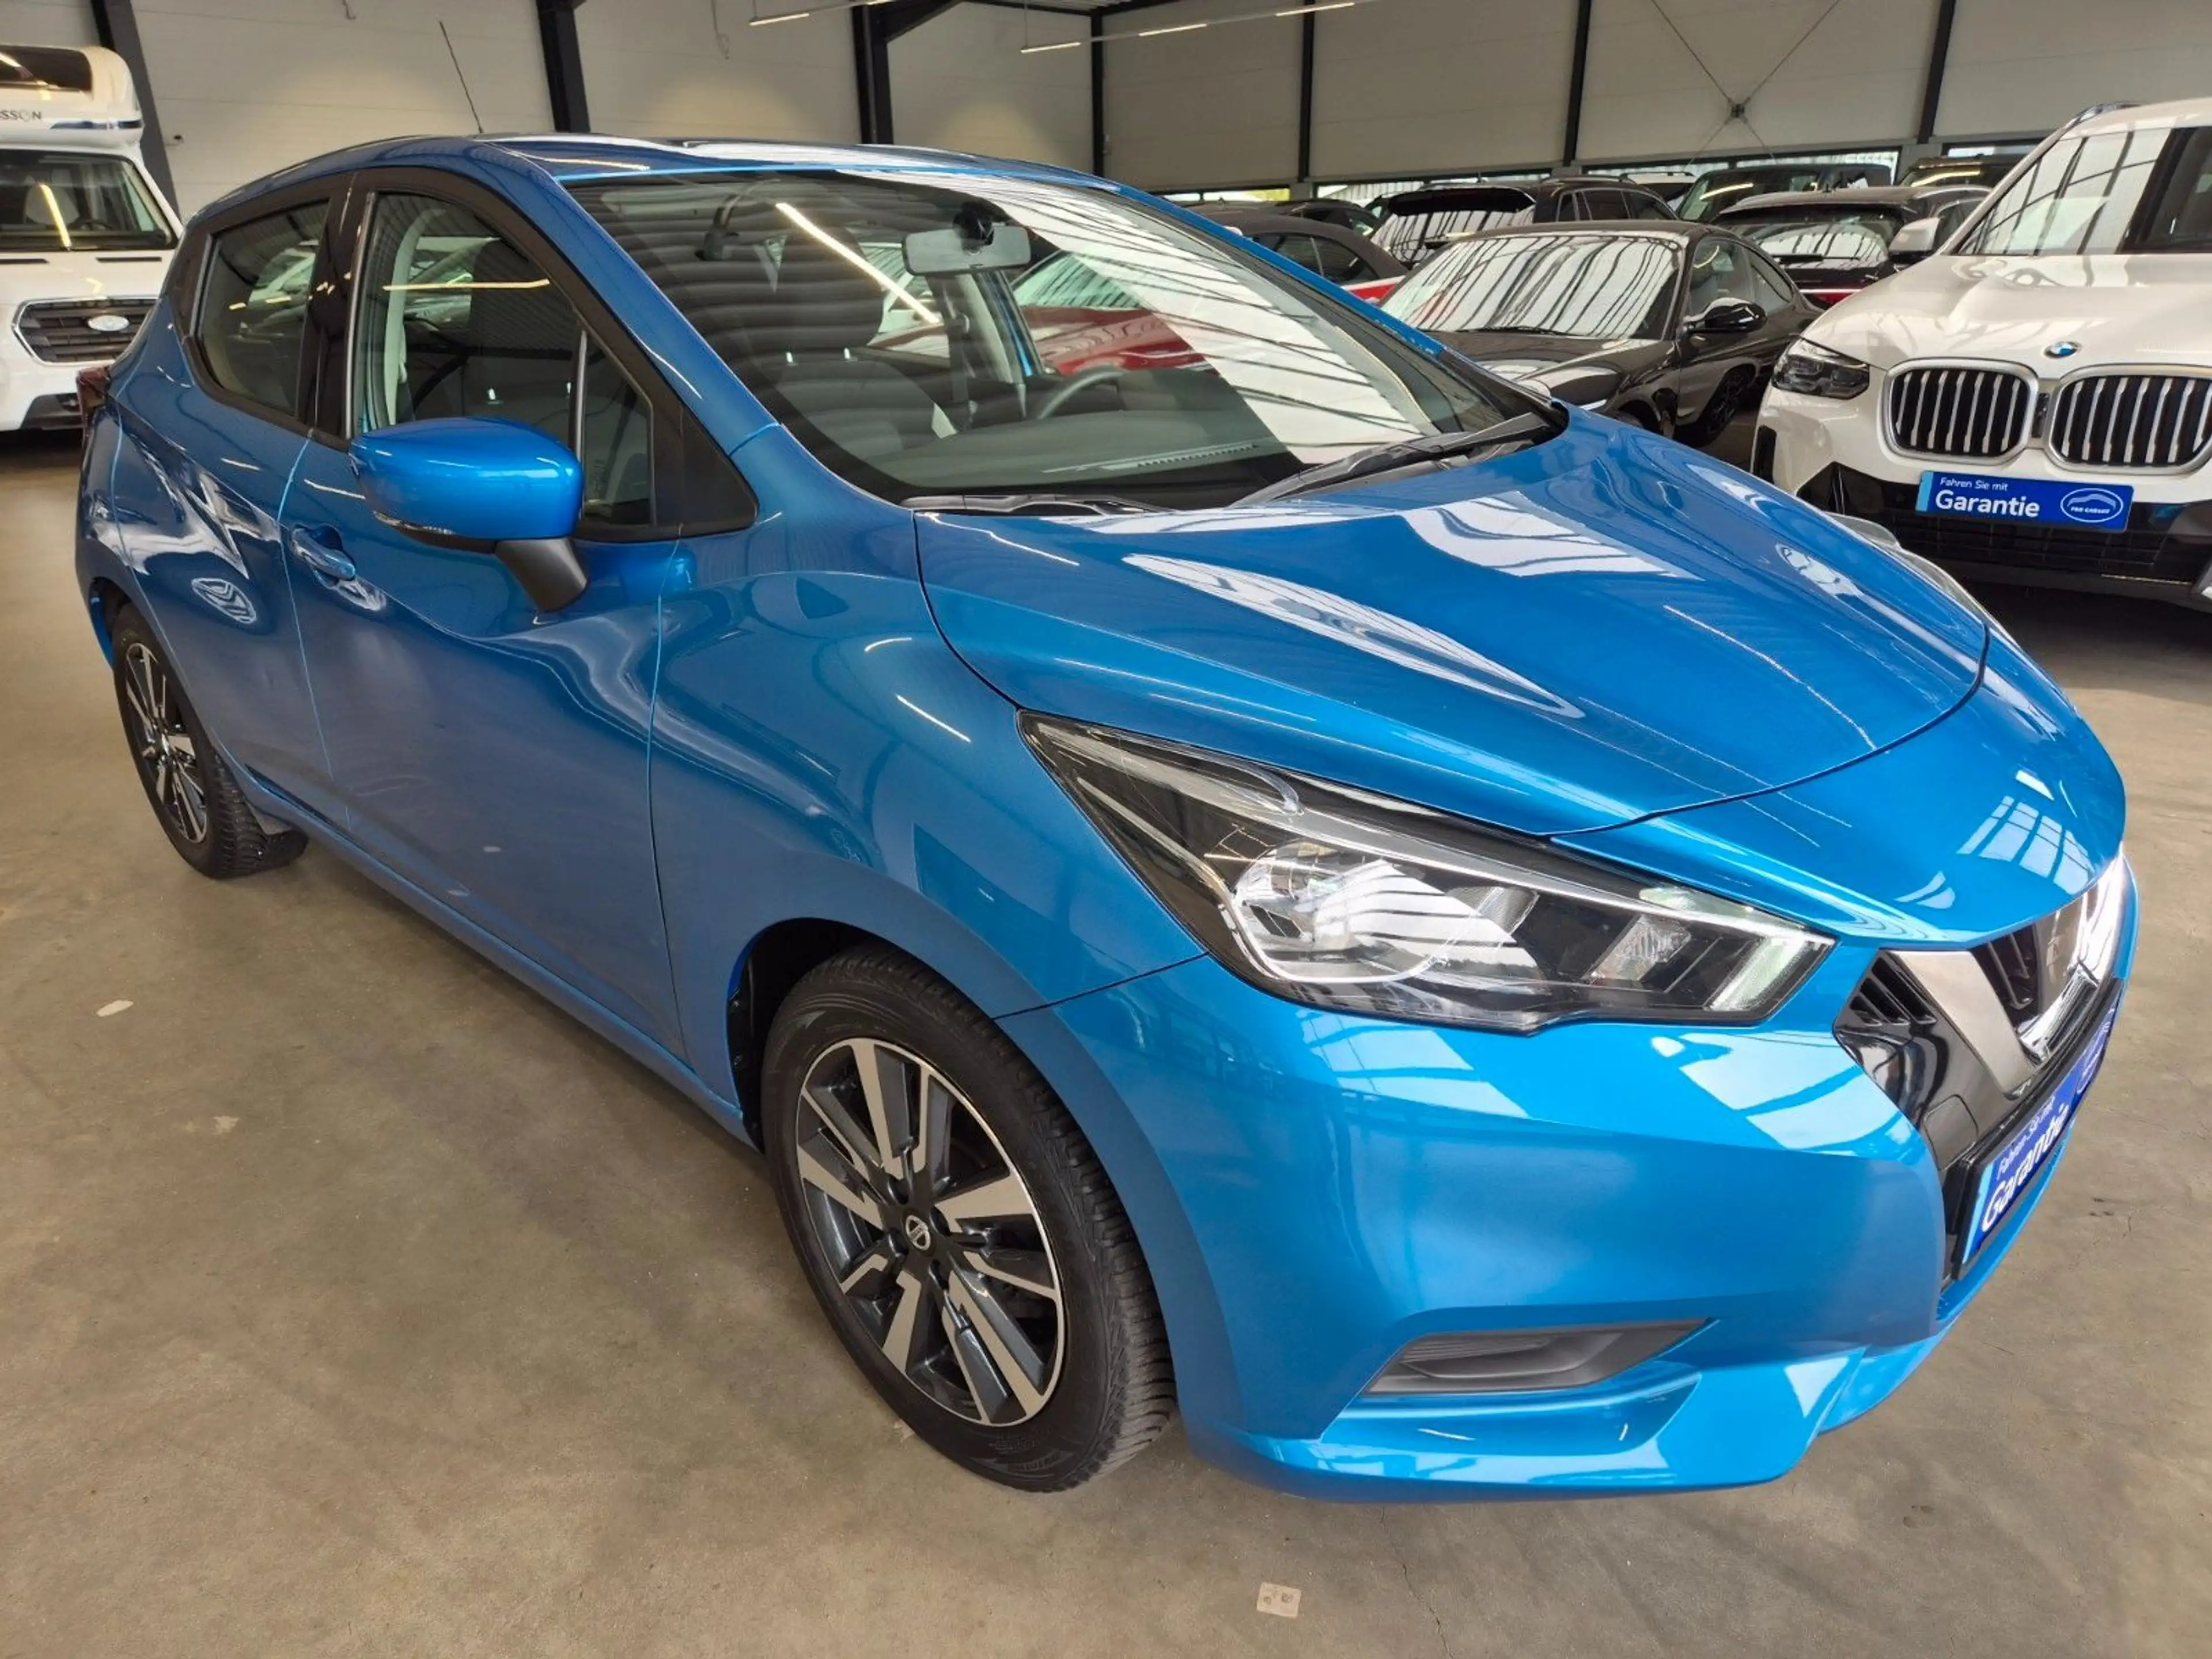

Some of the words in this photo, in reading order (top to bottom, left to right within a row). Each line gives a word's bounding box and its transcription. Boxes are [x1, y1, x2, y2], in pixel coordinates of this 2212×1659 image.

[1940, 476, 1972, 488] Fahren
[1974, 479, 1990, 490] Sie
[1992, 482, 2008, 491] mit
[1935, 489, 2040, 517] Garantie
[1982, 1103, 2069, 1232] Garantie
